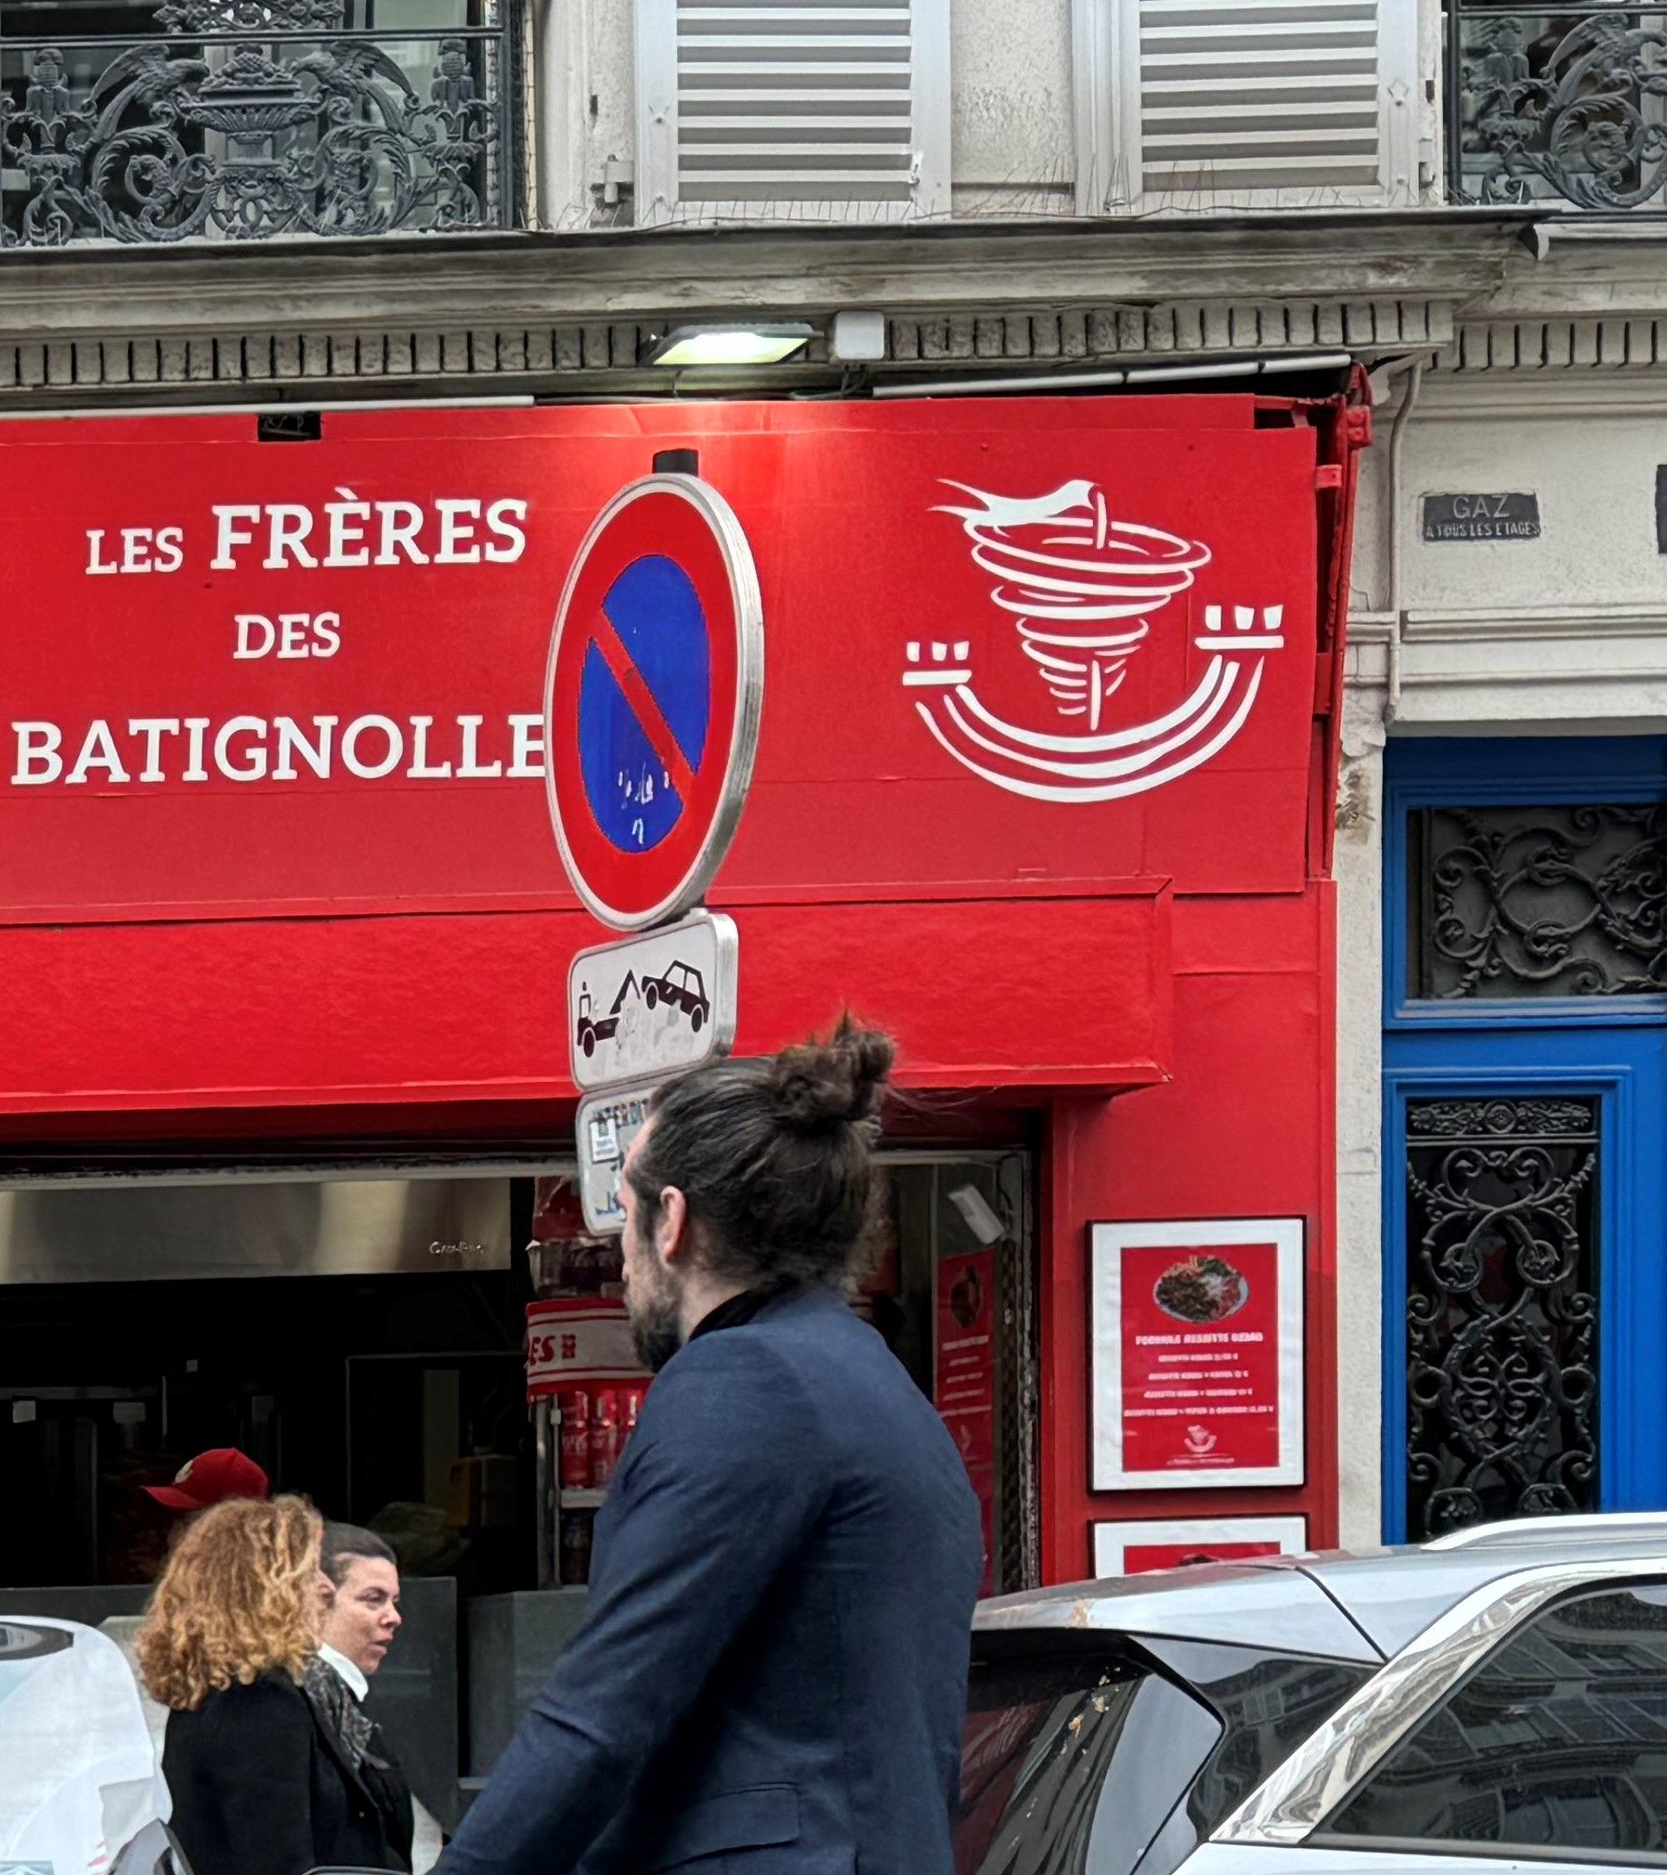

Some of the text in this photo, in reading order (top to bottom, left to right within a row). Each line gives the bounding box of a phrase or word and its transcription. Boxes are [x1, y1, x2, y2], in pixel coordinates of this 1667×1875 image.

[84, 486, 528, 575] LES FRÈRES
[1453, 494, 1510, 519] GAZ
[1469, 522, 1493, 536] LES
[233, 611, 341, 659] DES
[10, 713, 545, 786] BATIGNOLLE
